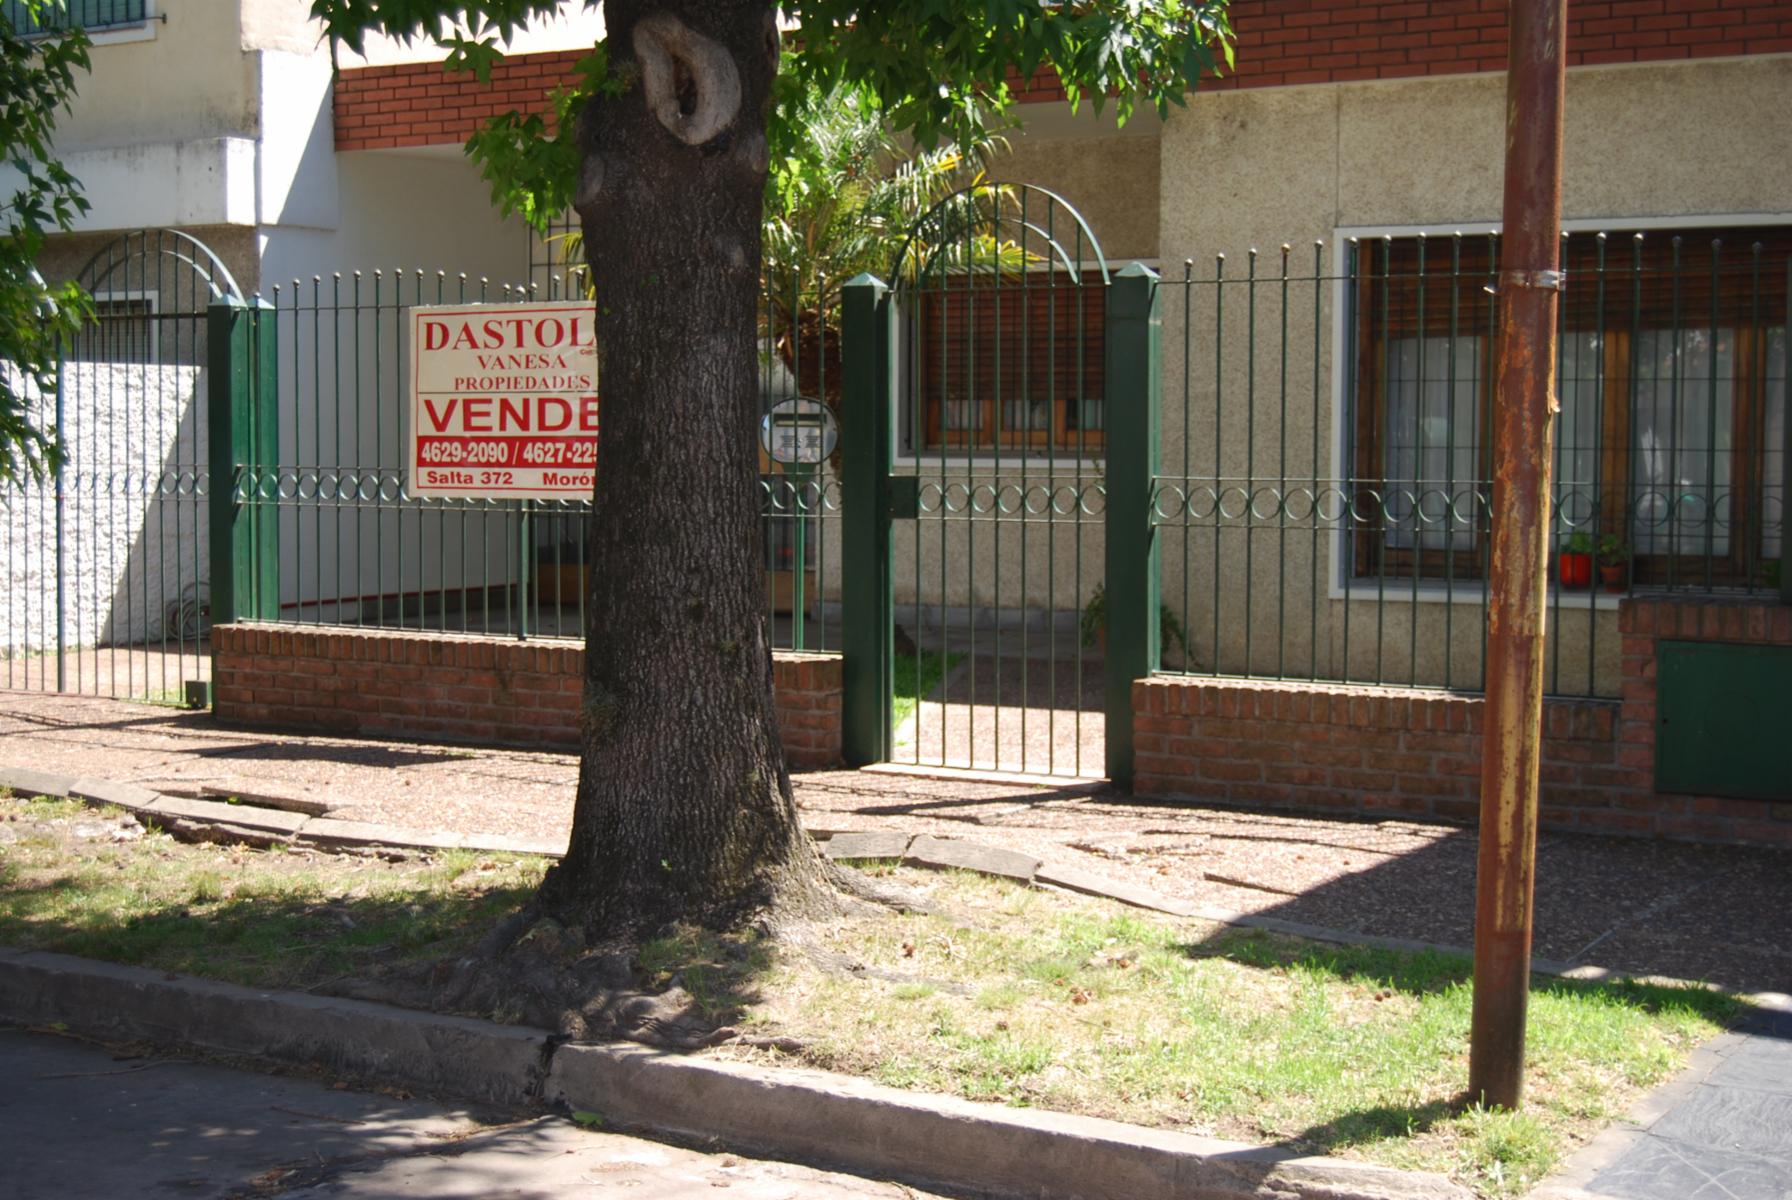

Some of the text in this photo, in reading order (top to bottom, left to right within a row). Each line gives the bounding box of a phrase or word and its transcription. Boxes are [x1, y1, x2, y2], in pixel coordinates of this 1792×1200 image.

[477, 354, 567, 370] VANESA
[454, 375, 591, 391] PROPIEDADES
[423, 396, 599, 433] VENDE
[421, 441, 509, 464] 4629-2090
[426, 471, 474, 485] Salta
[480, 471, 514, 485] 372
